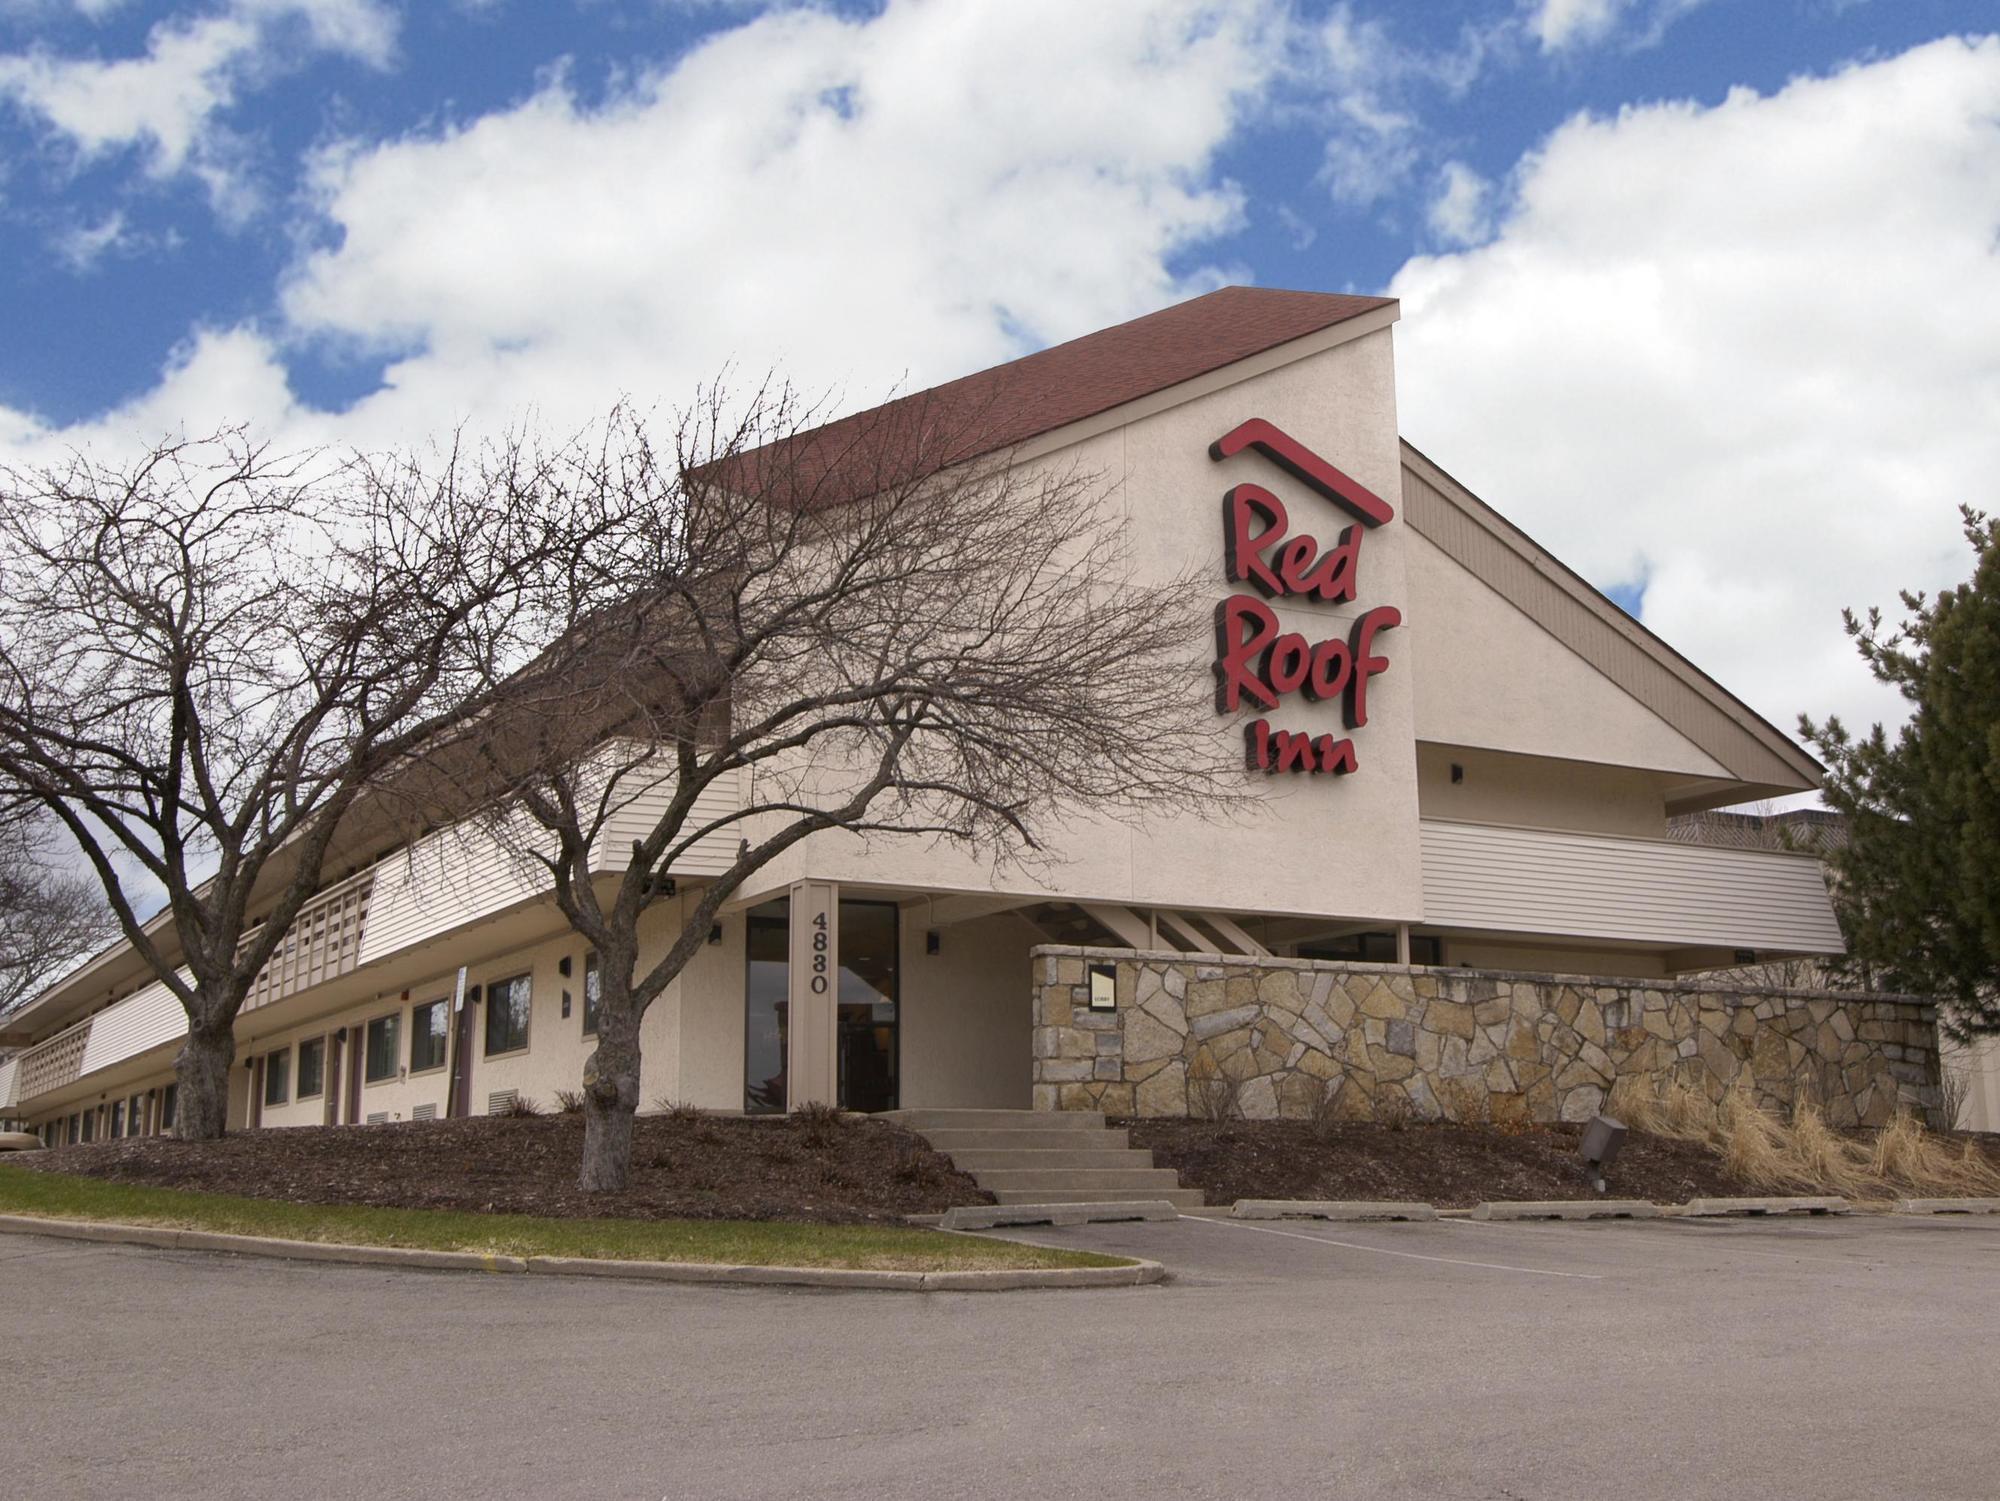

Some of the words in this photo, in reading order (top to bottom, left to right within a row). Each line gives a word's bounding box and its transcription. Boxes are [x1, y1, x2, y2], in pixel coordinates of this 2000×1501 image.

[1223, 483, 1363, 604] Red
[1212, 595, 1401, 729] Roof
[811, 912, 828, 994] 4830
